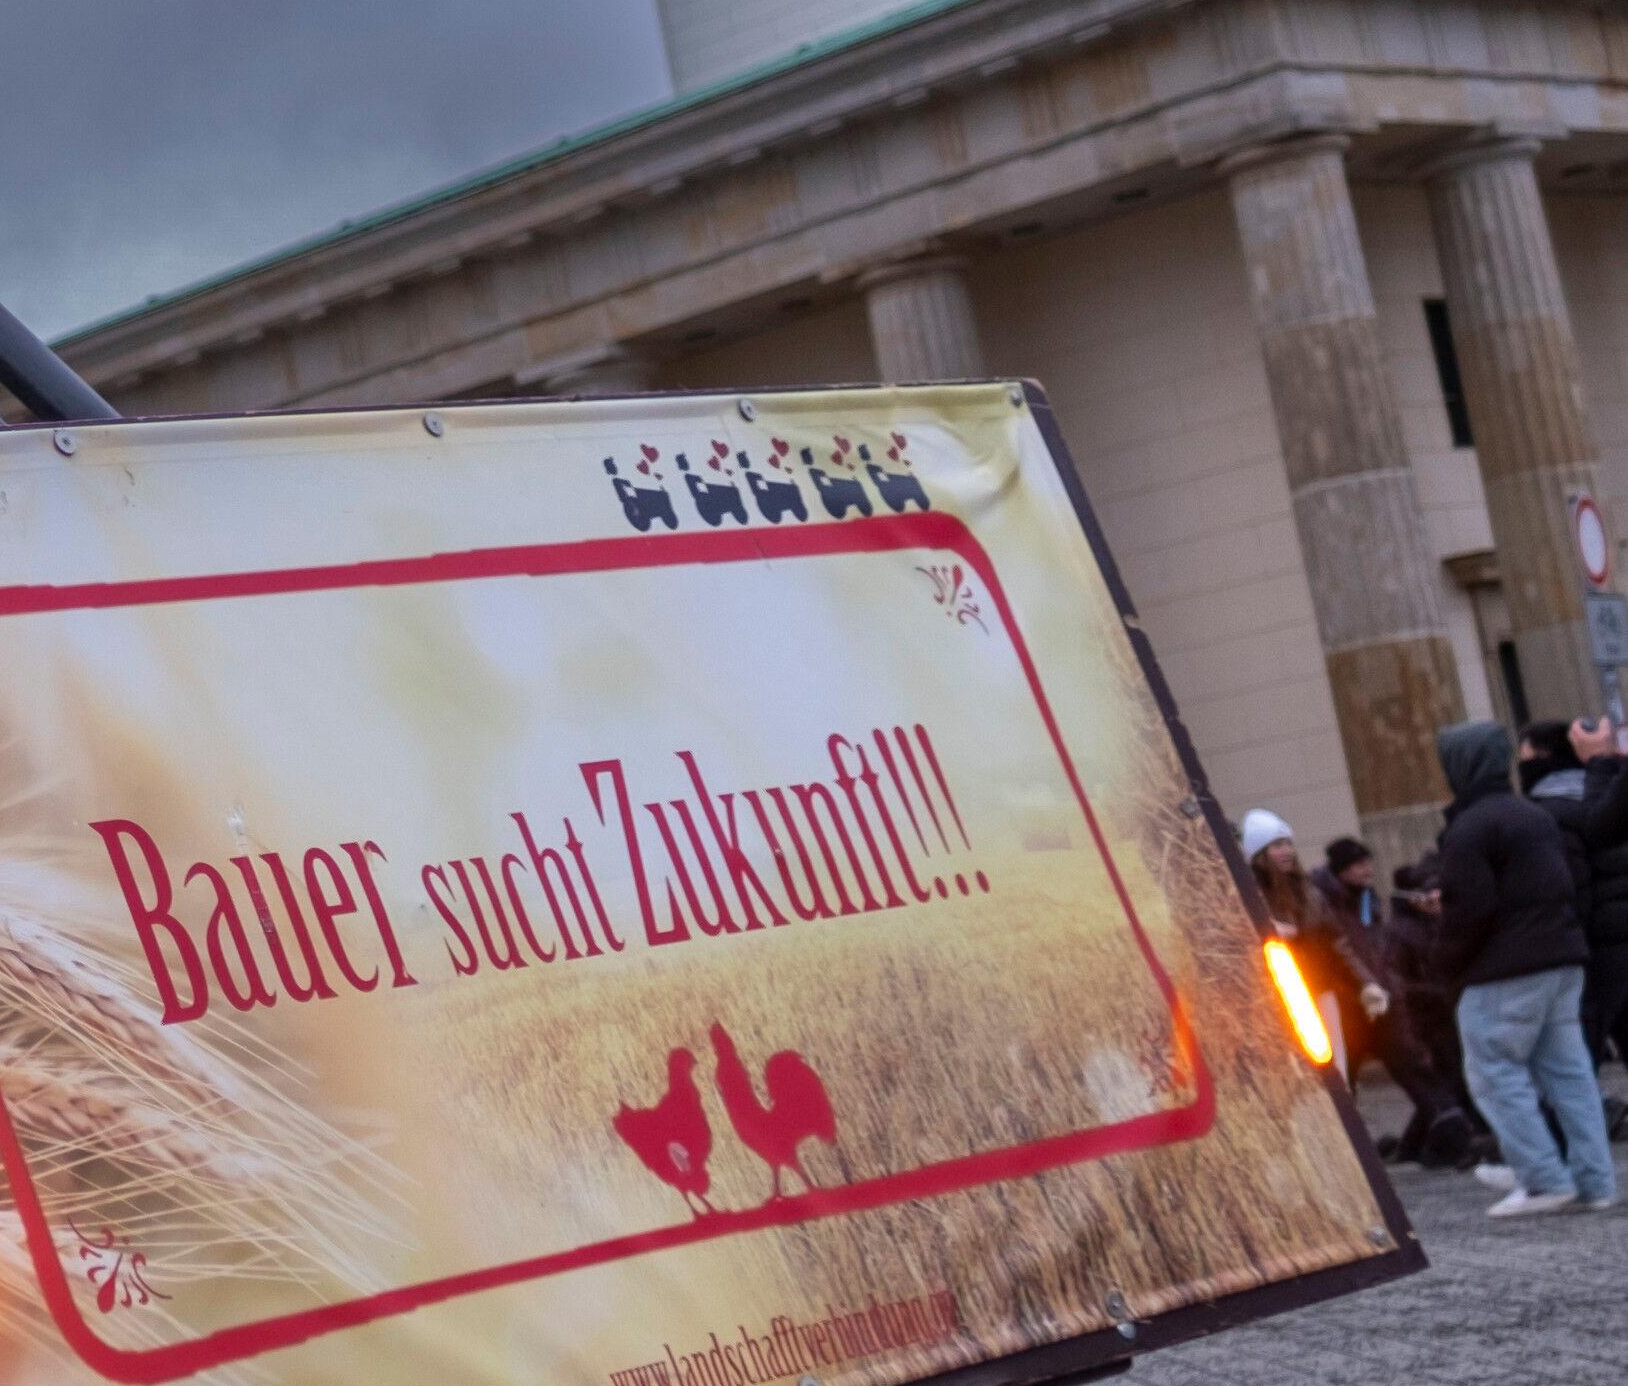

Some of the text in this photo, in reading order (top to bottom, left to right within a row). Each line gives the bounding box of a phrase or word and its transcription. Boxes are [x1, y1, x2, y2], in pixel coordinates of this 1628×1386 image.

[87, 722, 992, 1027] Bauer sucht Zukunft!!!
